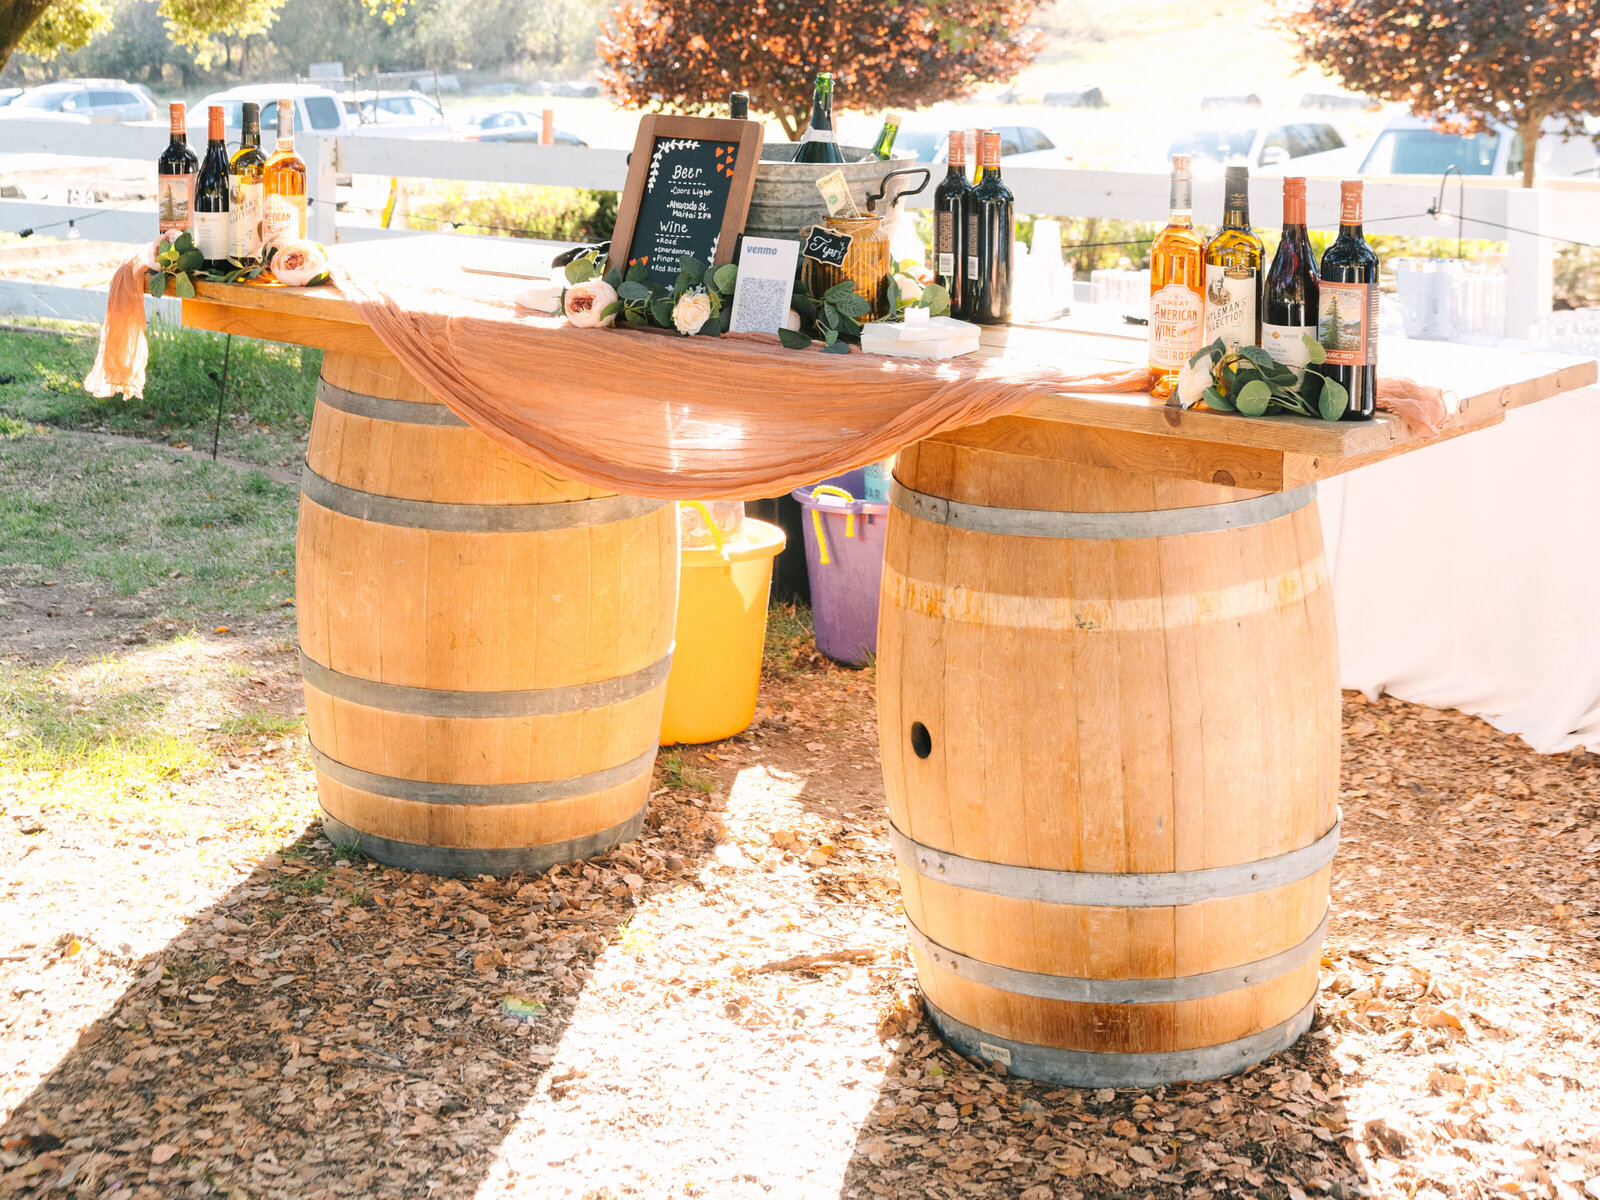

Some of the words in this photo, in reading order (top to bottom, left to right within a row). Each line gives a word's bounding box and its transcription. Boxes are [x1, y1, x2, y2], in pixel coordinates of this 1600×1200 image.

[671, 164, 703, 180] Beer
[672, 186, 691, 195] Coors
[692, 188, 713, 198] Light
[265, 212, 291, 222] MERICAN
[672, 210, 697, 219] Maitai
[697, 212, 712, 220] IPA
[659, 221, 689, 233] Wine
[657, 246, 696, 258] Chardonnay
[746, 245, 778, 256] venmo
[656, 254, 675, 263] Pinot
[654, 264, 666, 272] Red
[667, 265, 682, 273] Blen
[1153, 303, 1198, 322] AMERICAN
[1154, 323, 1177, 342] WINE
